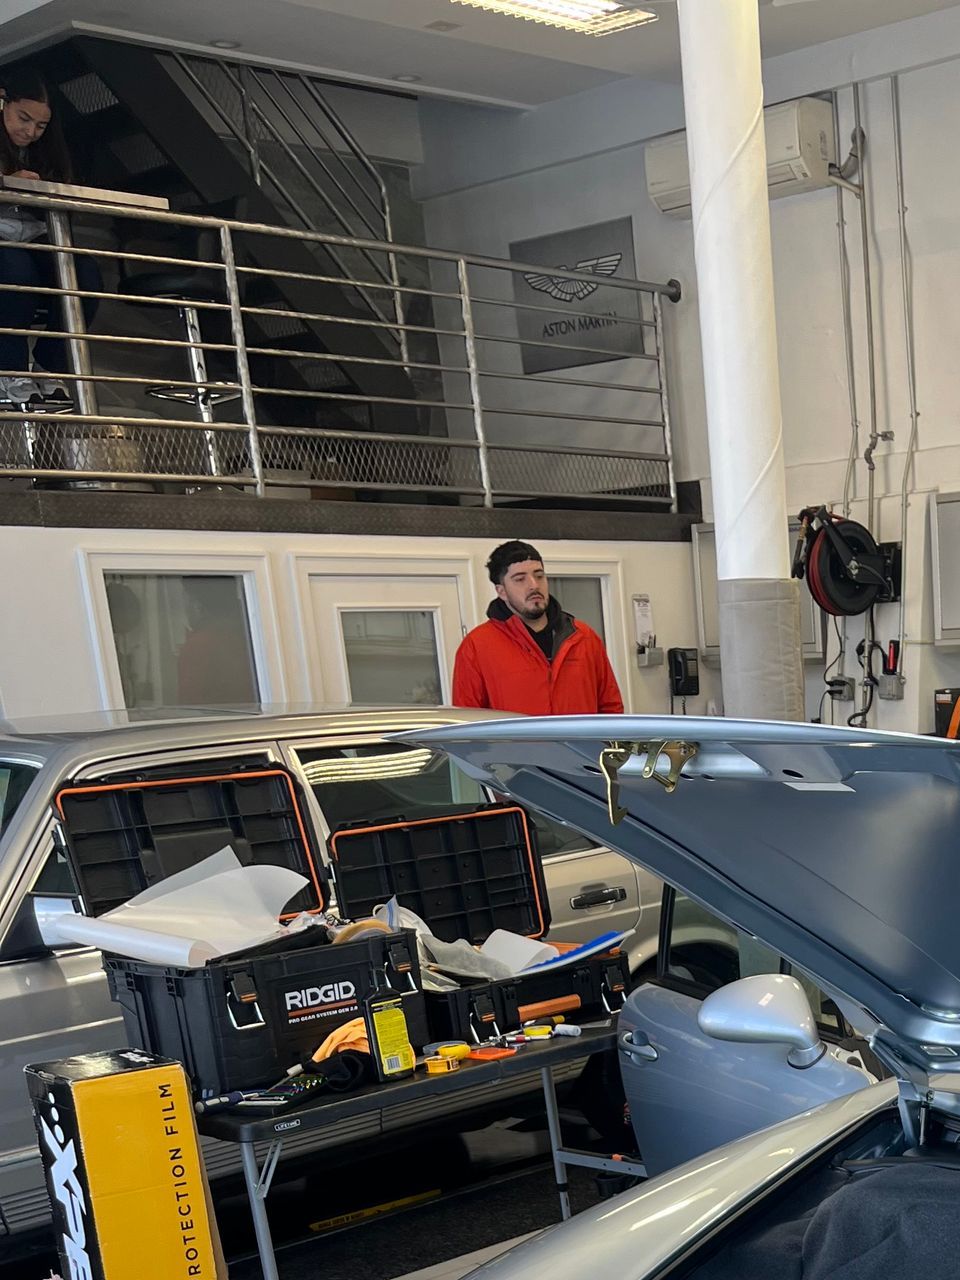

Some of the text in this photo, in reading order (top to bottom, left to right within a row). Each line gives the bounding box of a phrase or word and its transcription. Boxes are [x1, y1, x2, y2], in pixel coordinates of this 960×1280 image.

[543, 319, 576, 338] ASTON
[285, 981, 356, 1010] RIDGID
[158, 1083, 179, 1136] FILM
